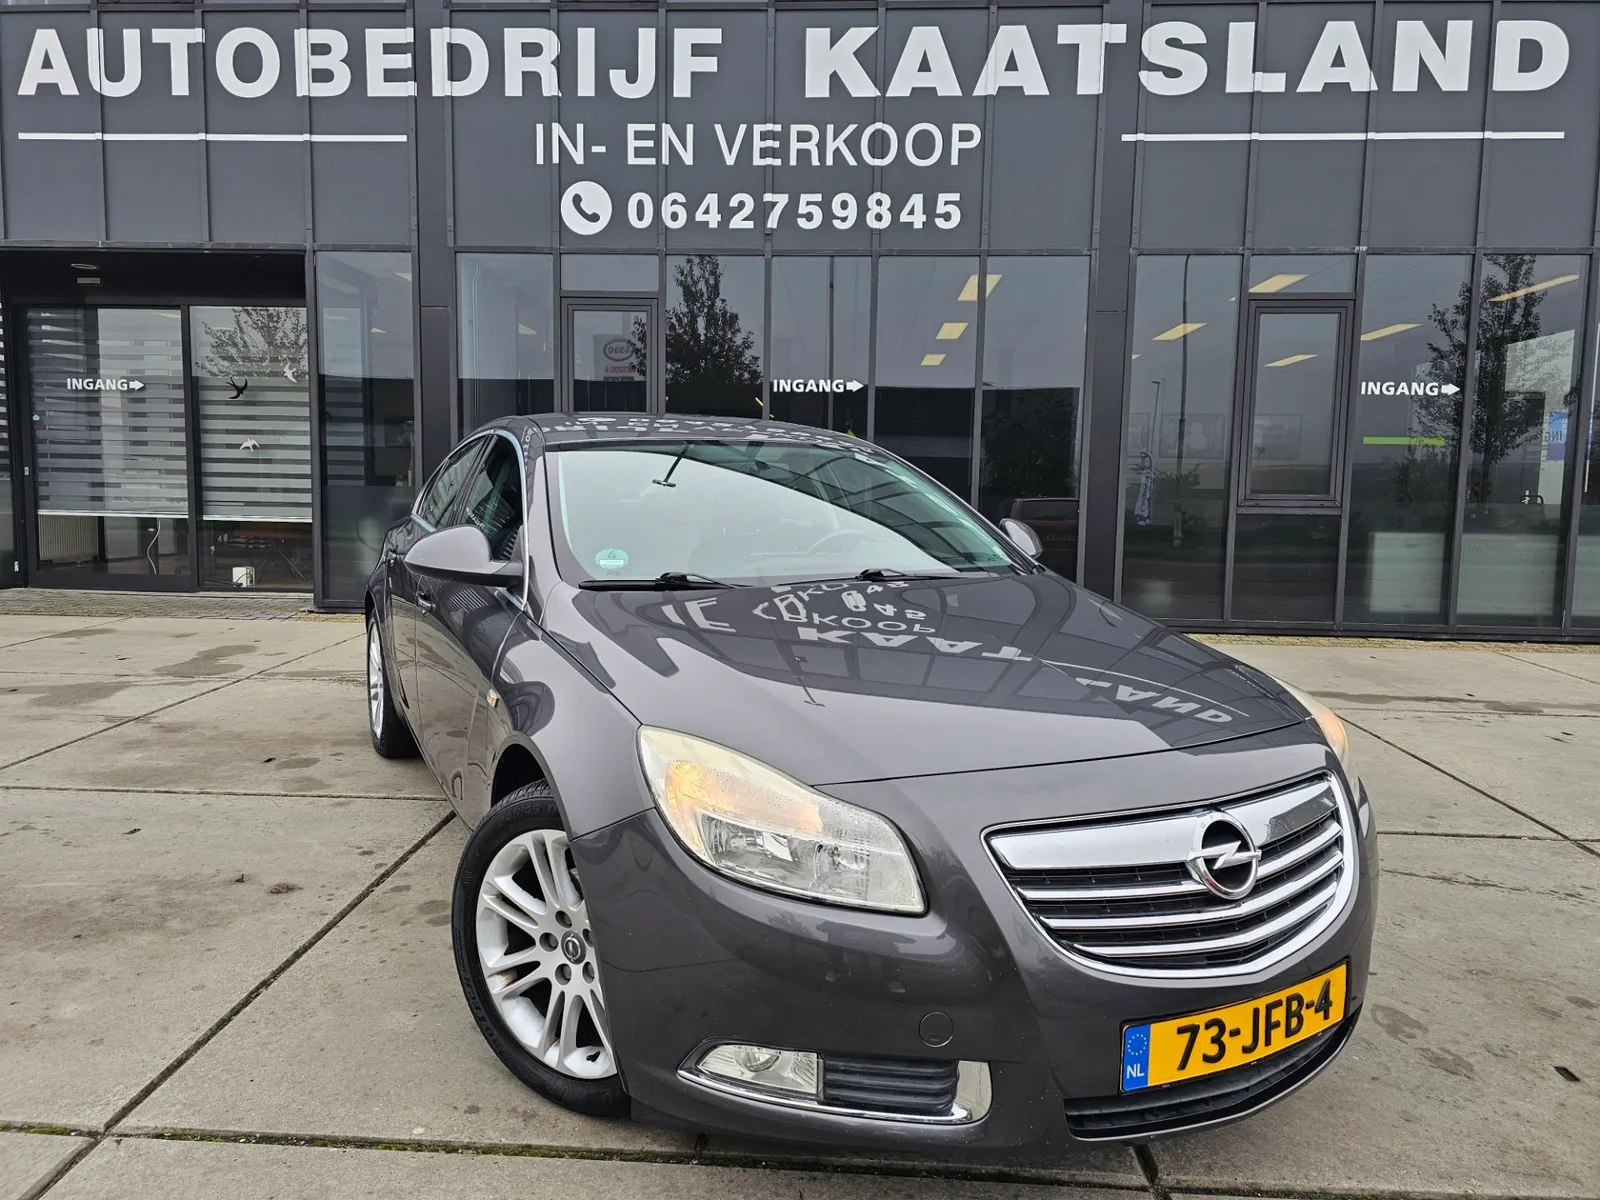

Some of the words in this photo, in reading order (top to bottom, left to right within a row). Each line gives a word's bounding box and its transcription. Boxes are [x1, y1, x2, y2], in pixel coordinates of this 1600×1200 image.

[18, 27, 722, 98] AUTOBEDRIJF
[806, 20, 1569, 97] KAATSLAND
[536, 123, 606, 165] IN-
[627, 123, 693, 165] EN
[714, 122, 981, 166] VERKOOP
[628, 192, 961, 229] 0642759845
[67, 378, 128, 391] INGANG
[773, 378, 844, 393] INGANG
[1361, 381, 1439, 396] INGANG
[1177, 979, 1332, 1071] 73-JFB-4
[1126, 1063, 1145, 1079] NL
